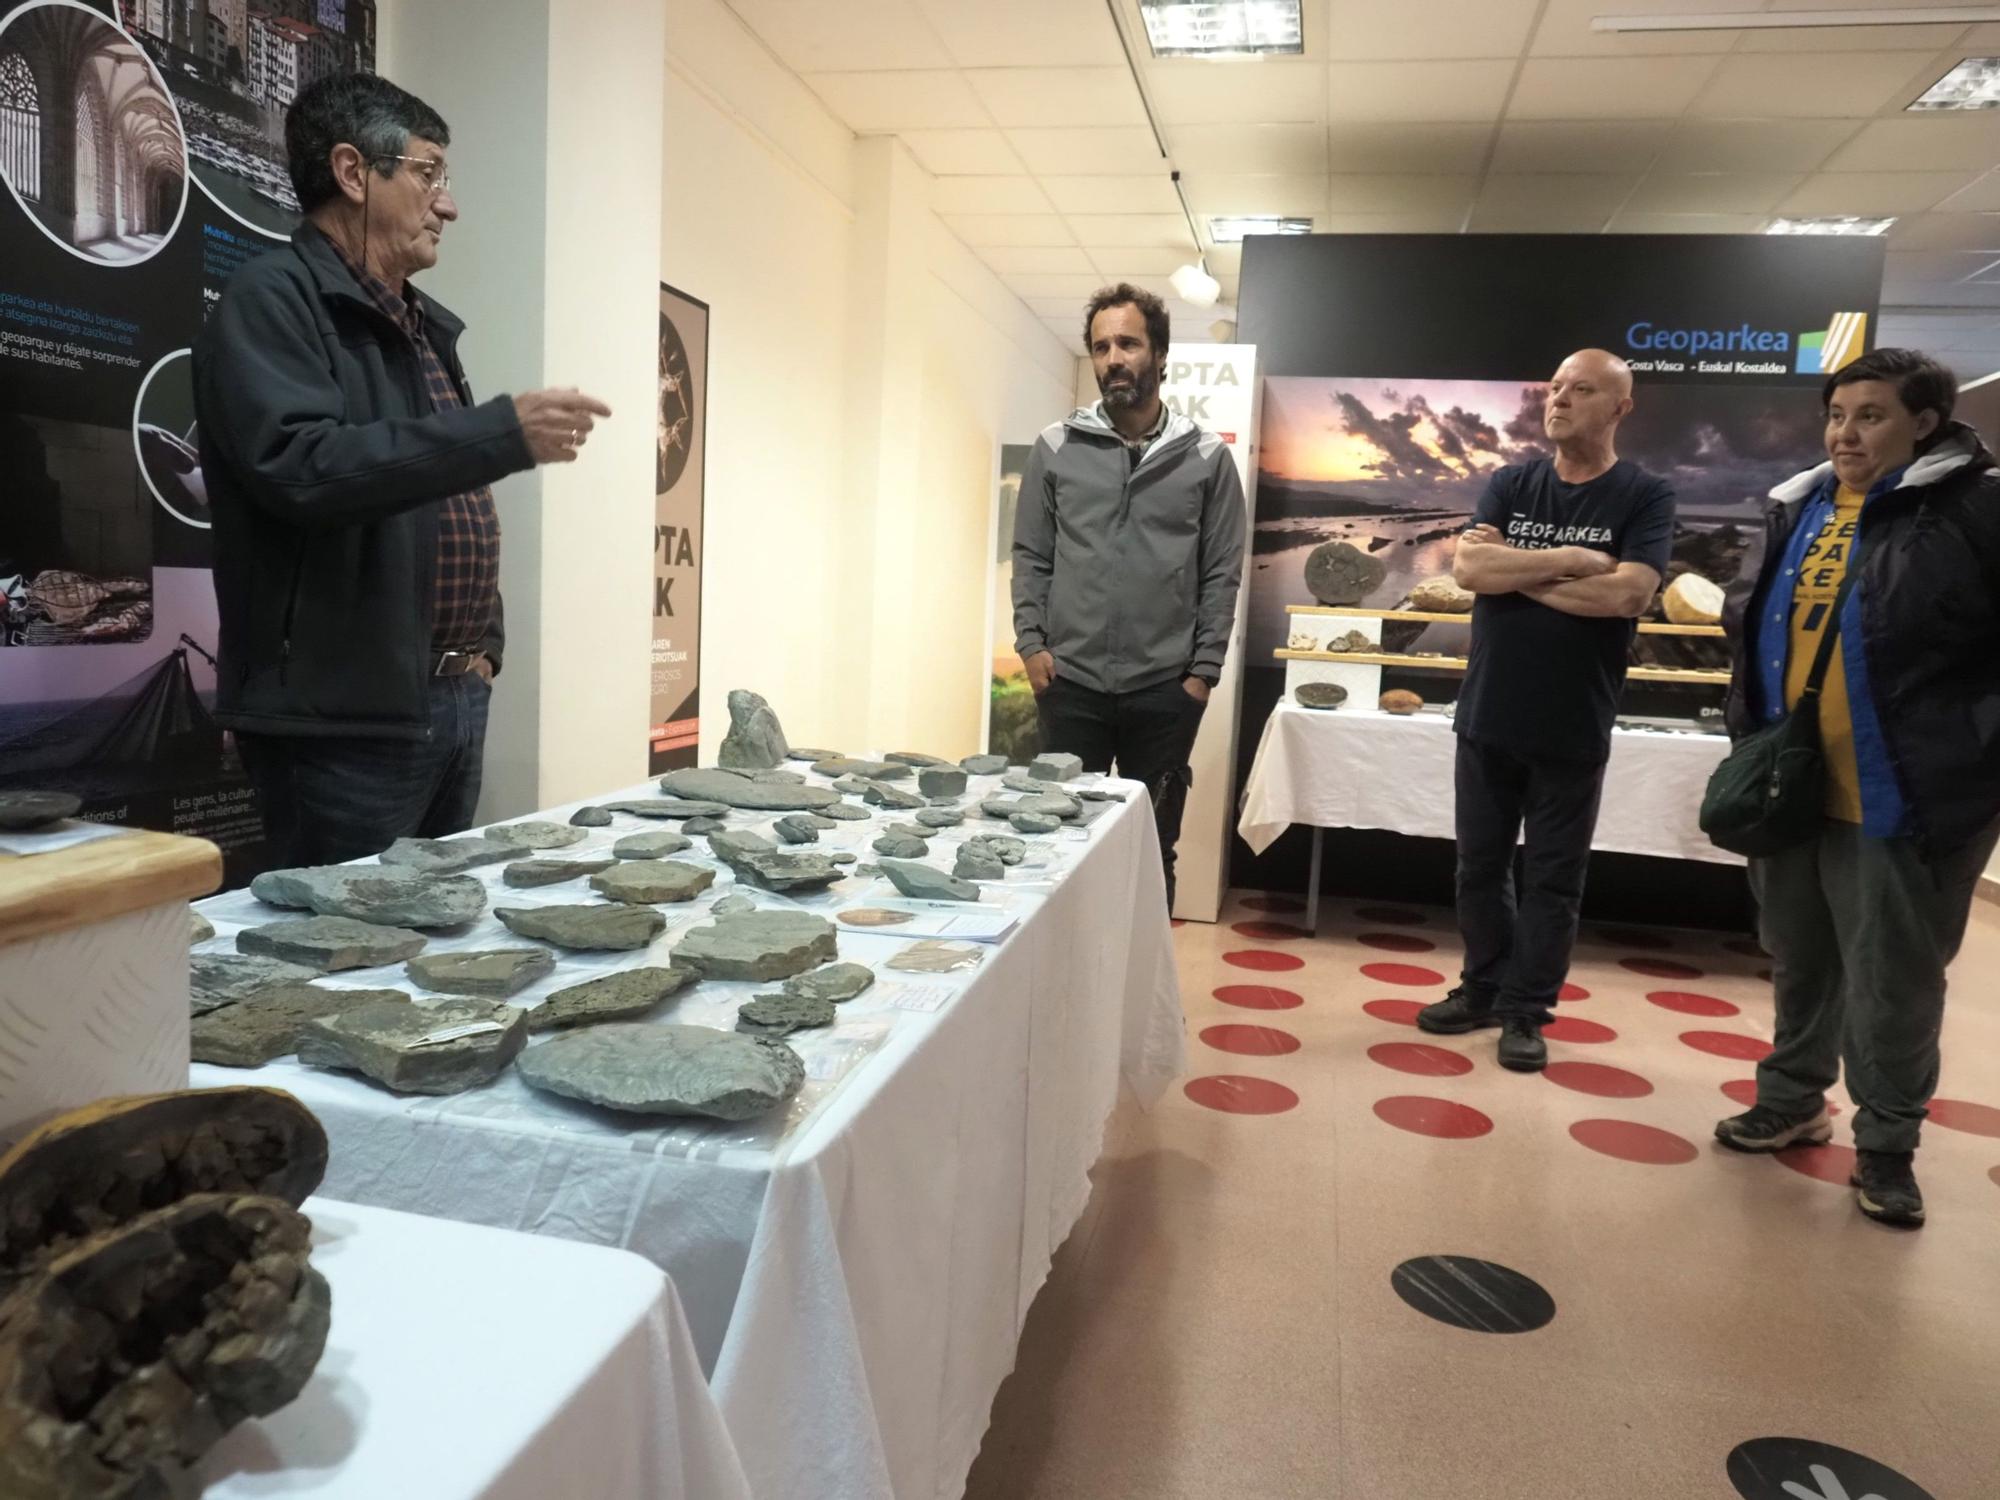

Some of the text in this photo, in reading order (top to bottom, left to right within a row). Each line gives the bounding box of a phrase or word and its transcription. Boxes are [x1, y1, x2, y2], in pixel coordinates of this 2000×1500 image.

[1, 330, 54, 351] geoparque
[55, 342, 62, 354] y
[92, 349, 142, 368] sorprender
[1626, 322, 1789, 355] Geoparkea
[10, 347, 30, 360] sus
[1165, 361, 1240, 386] PTA
[1625, 359, 1653, 371] Costa
[1654, 360, 1684, 372] Vasca
[1698, 360, 1732, 373] Euskal
[1735, 361, 1787, 374] Kostaldea
[1507, 519, 1613, 543] GEOPARKEA
[653, 577, 674, 618] K
